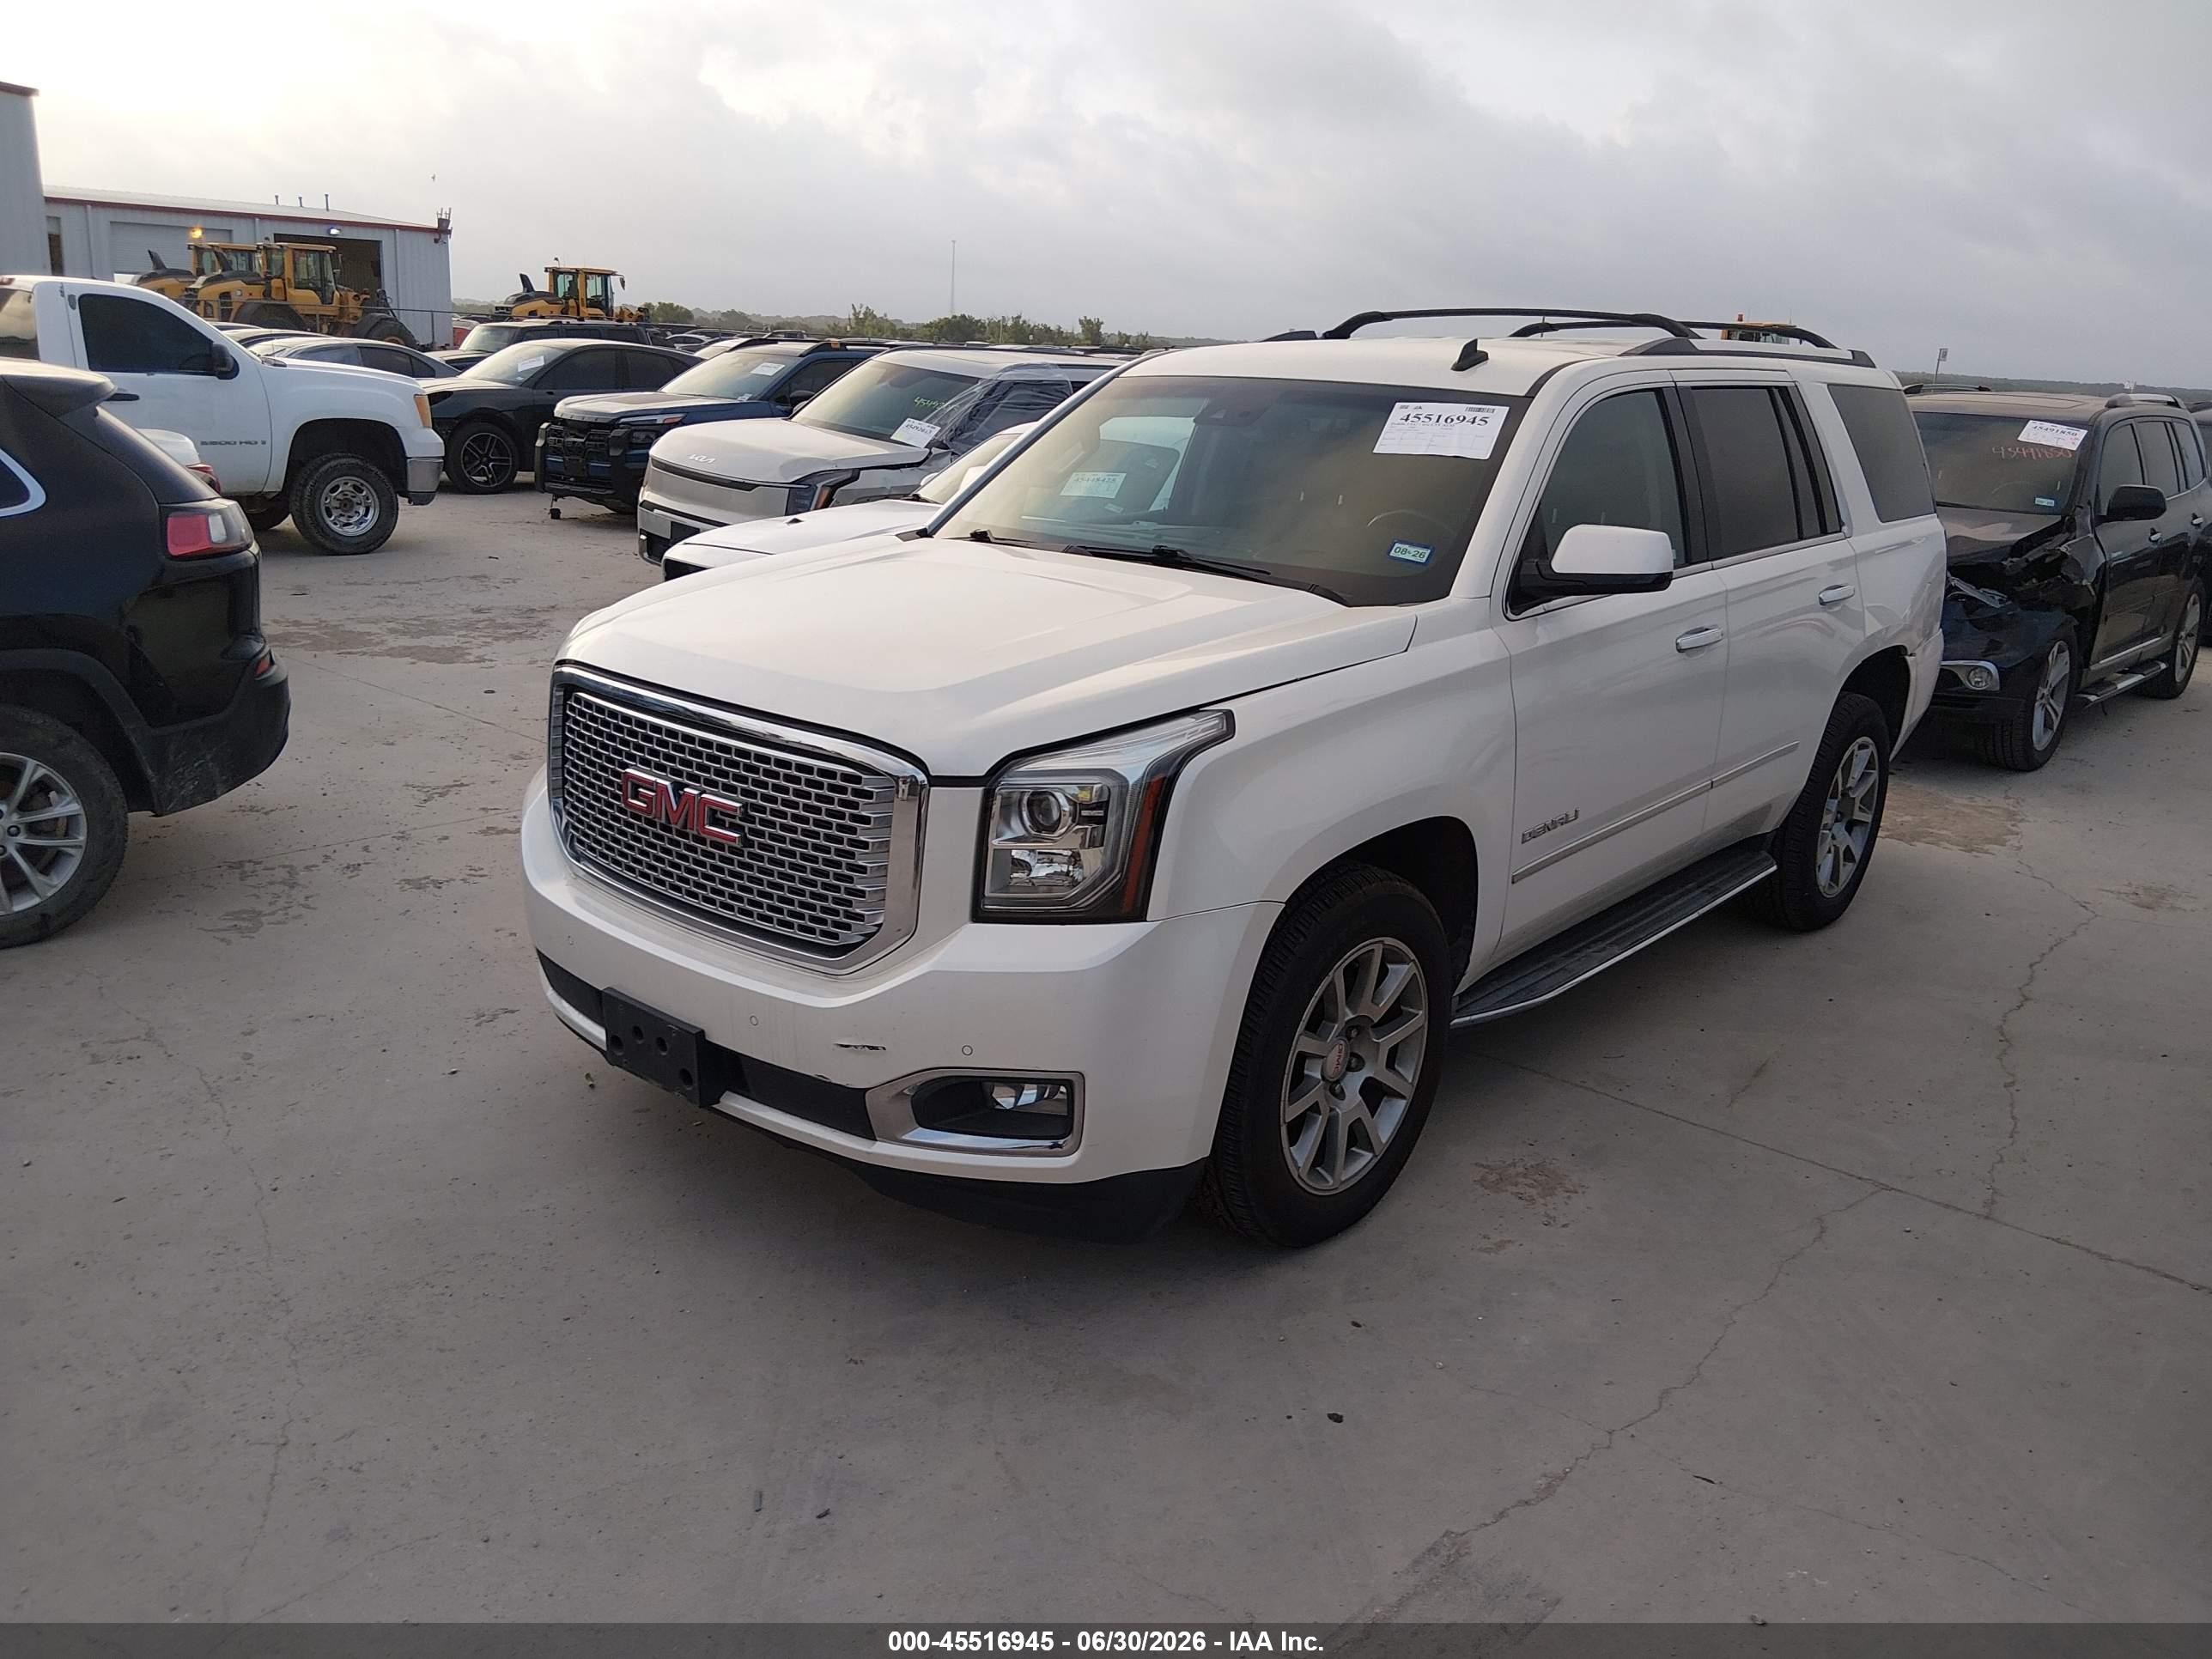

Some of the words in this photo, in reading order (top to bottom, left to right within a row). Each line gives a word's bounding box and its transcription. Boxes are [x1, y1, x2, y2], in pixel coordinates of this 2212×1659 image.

[1398, 412, 1491, 427] 45516945
[622, 767, 744, 845] GMC
[1521, 806, 1581, 845] DENALI
